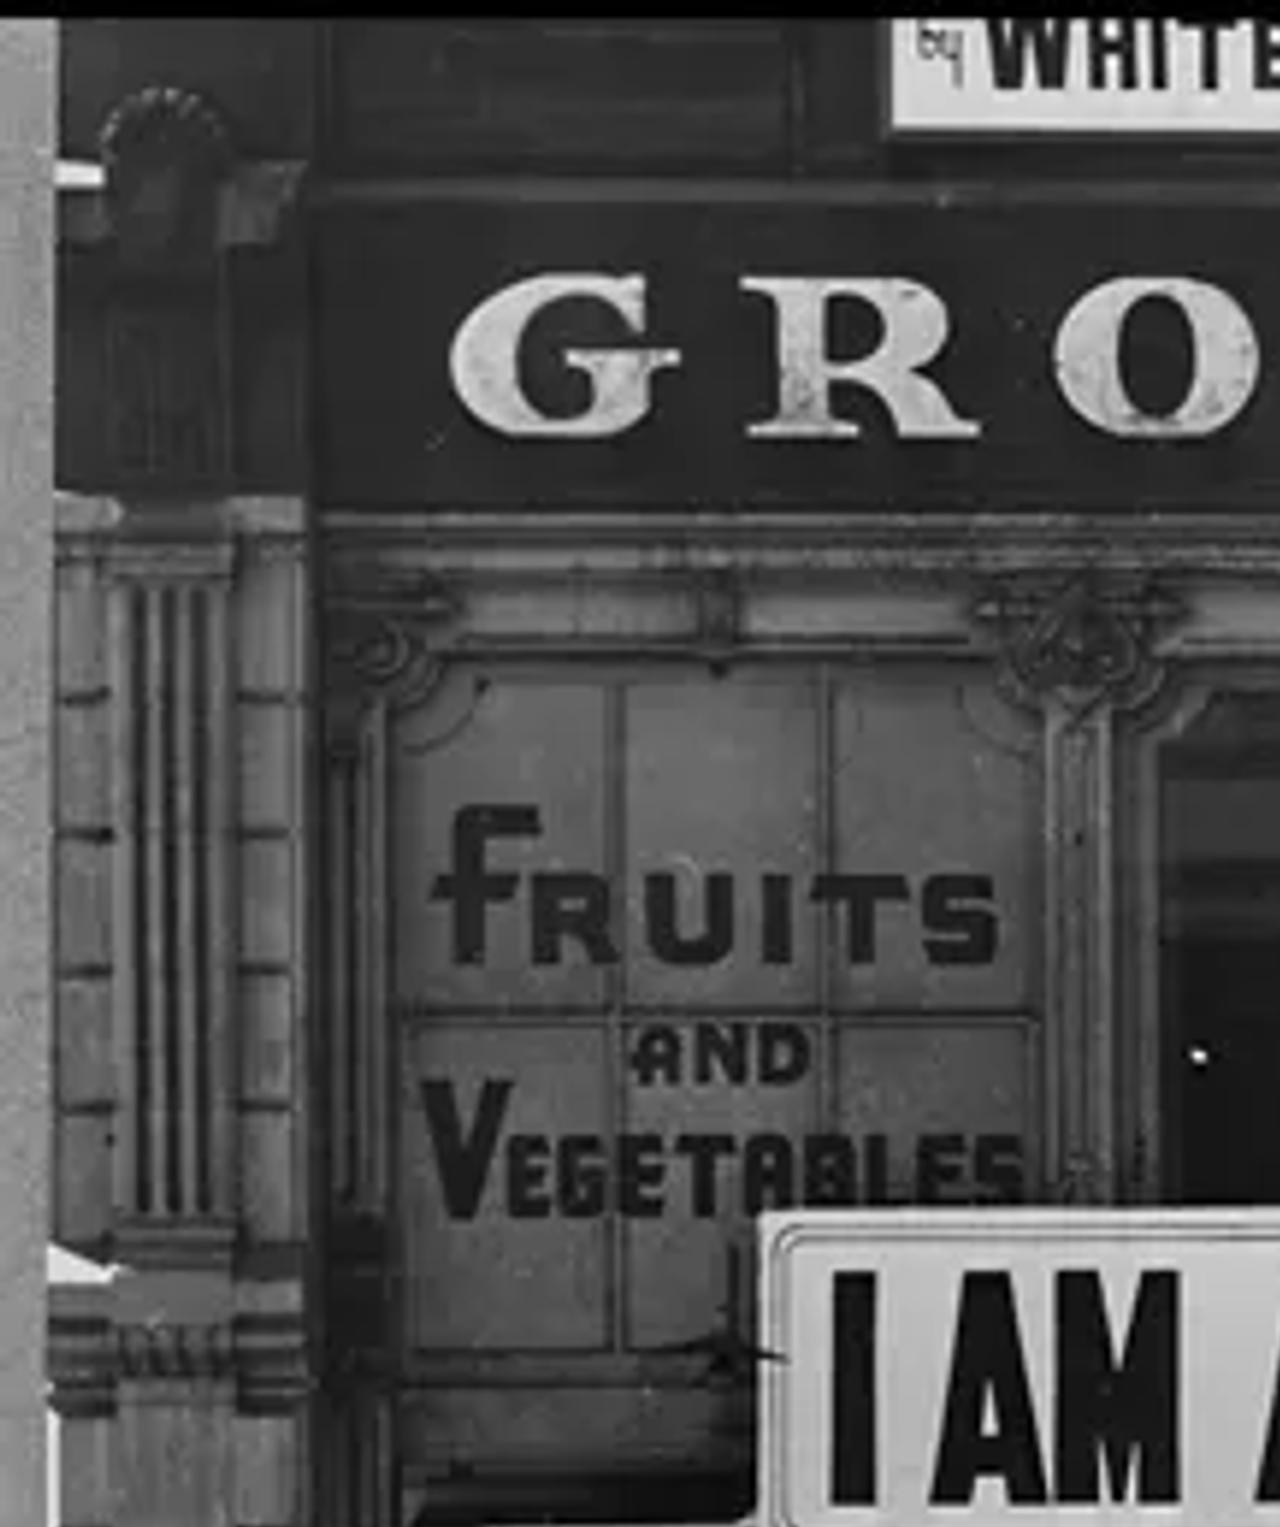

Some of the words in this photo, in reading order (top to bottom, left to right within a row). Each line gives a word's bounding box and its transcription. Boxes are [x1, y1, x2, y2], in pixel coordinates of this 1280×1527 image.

[631, 1021, 813, 1086] AND
[420, 1078, 1024, 1220] VEGETABLES
[829, 1270, 877, 1506] I
[929, 1269, 1182, 1506] AM
